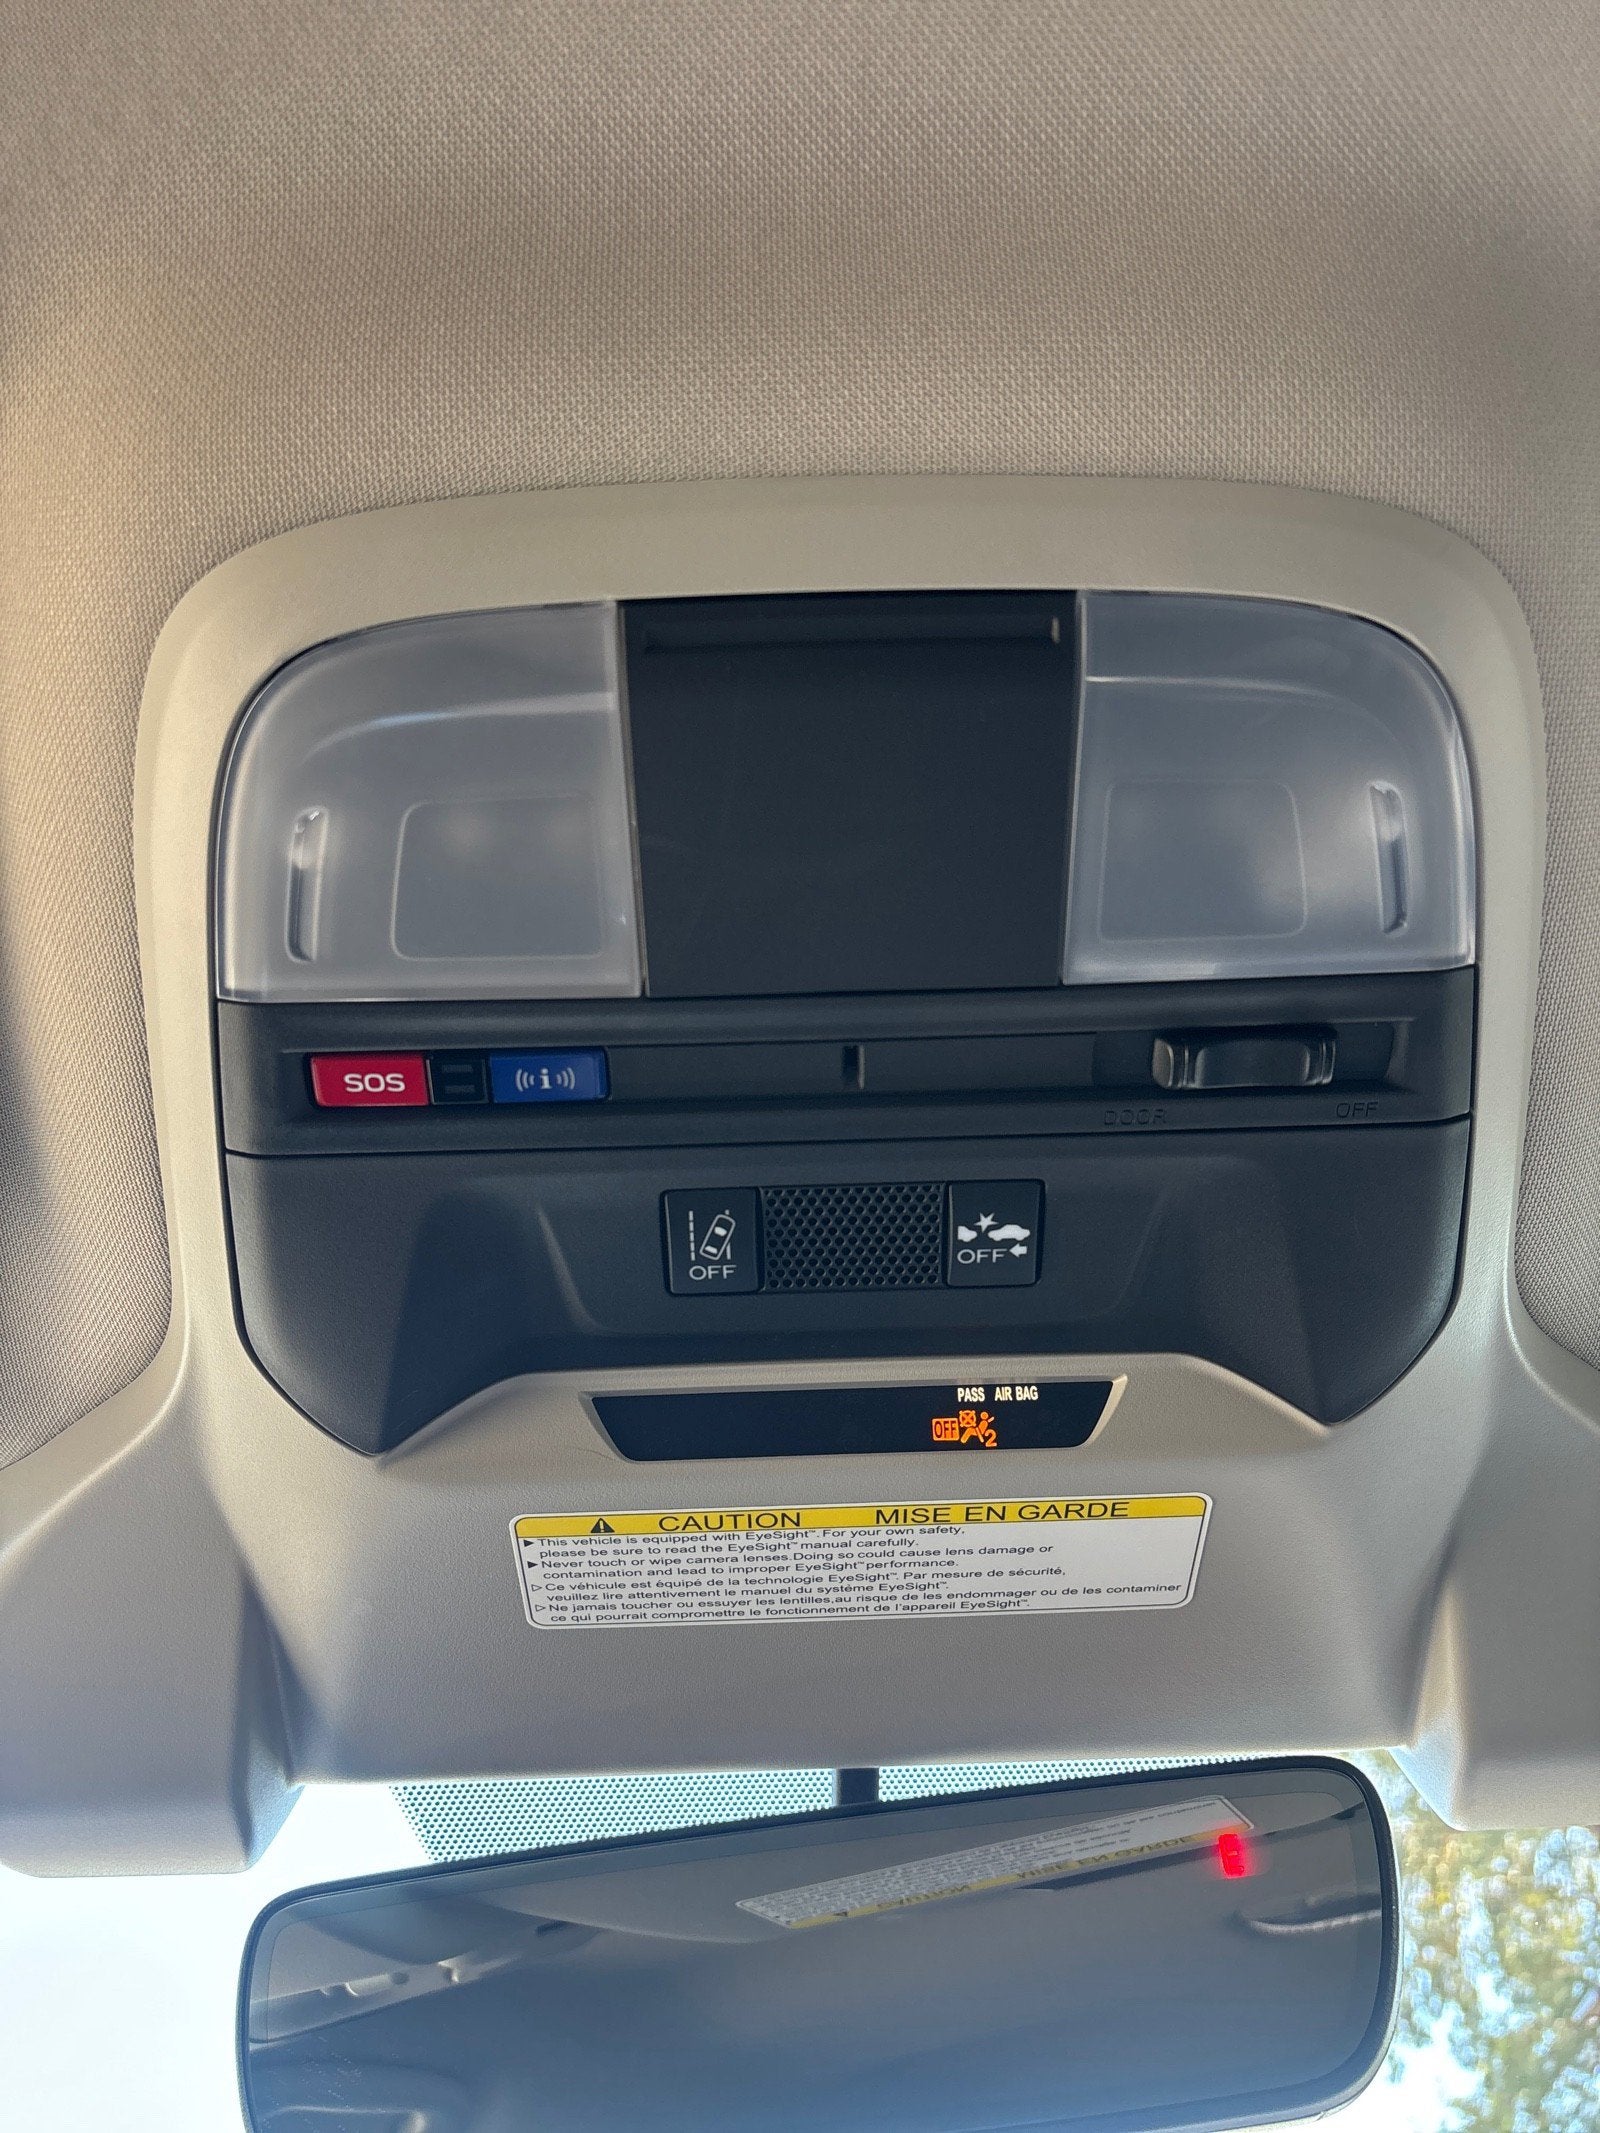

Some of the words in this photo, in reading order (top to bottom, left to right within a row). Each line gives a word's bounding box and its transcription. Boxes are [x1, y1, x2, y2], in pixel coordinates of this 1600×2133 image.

[343, 1073, 406, 1093] SOS
[1336, 1101, 1379, 1119] OFF
[957, 1248, 1007, 1264] OFF
[689, 1264, 737, 1280] OFF
[957, 1387, 985, 1402] PASS
[994, 1386, 1013, 1401] AIR
[1015, 1385, 1039, 1401] BAG
[934, 1420, 957, 1439] OFF
[985, 1429, 997, 1447] 2
[658, 1512, 801, 1532] CAUTION
[875, 1508, 952, 1525] MISE
[964, 1505, 1006, 1522] EN
[1018, 1501, 1130, 1521] GARDE
[538, 1538, 568, 1547] This
[571, 1536, 622, 1546] vehicle
[626, 1536, 638, 1544] is
[642, 1533, 707, 1545] equipped
[712, 1532, 741, 1541] with
[850, 1529, 882, 1539] your
[885, 1528, 914, 1536] own
[539, 1549, 586, 1560] please
[590, 1548, 609, 1557] be
[612, 1548, 644, 1556] sure
[665, 1545, 697, 1554] read
[701, 1544, 723, 1553] the
[800, 1539, 852, 1549] manual
[856, 1538, 919, 1548] carefully.
[541, 1560, 584, 1569] Never
[587, 1558, 627, 1567] touch
[648, 1556, 682, 1567] wipe
[686, 1556, 739, 1565] camera
[857, 1549, 895, 1559] could
[945, 1547, 974, 1556] lens
[978, 1546, 1035, 1556] damage
[543, 1569, 643, 1580] contamination
[647, 1567, 673, 1576] and
[677, 1566, 707, 1575] lead
[711, 1566, 725, 1574] to
[728, 1565, 791, 1575] improper
[866, 1560, 959, 1571] performance.
[545, 1583, 565, 1591] Ce
[568, 1581, 627, 1591] véhicule
[630, 1581, 652, 1589] est
[655, 1578, 703, 1589] équipé
[706, 1578, 724, 1587] de
[728, 1578, 740, 1586] la
[744, 1575, 824, 1585] technologie
[903, 1571, 928, 1580] Par
[931, 1571, 983, 1579] mesure
[986, 1569, 1004, 1577] de
[546, 1593, 599, 1602] veuillez
[602, 1592, 624, 1600] lire
[627, 1589, 721, 1599] attentivement
[724, 1588, 737, 1597] le
[741, 1586, 791, 1596] manuel
[795, 1586, 813, 1594] du
[817, 1584, 874, 1595] système
[548, 1604, 569, 1612] Ne
[572, 1602, 617, 1613] jamais
[621, 1601, 673, 1610] toucher
[676, 1601, 694, 1609] ou
[697, 1599, 752, 1608] essuyer
[755, 1598, 776, 1606] les
[856, 1594, 898, 1603] risque
[901, 1593, 919, 1601] de
[923, 1592, 943, 1600] les
[946, 1588, 1037, 1600] endommager
[1061, 1587, 1079, 1595] de
[1082, 1587, 1102, 1595] les
[1106, 1584, 1182, 1594] contaminer
[570, 1613, 592, 1623] qui
[595, 1612, 648, 1622] pourrait
[651, 1609, 745, 1620] compromettre
[749, 1608, 762, 1616] le
[765, 1605, 870, 1616] fonctionnement
[873, 1604, 891, 1612] de
[895, 1601, 956, 1612] l'appareil
